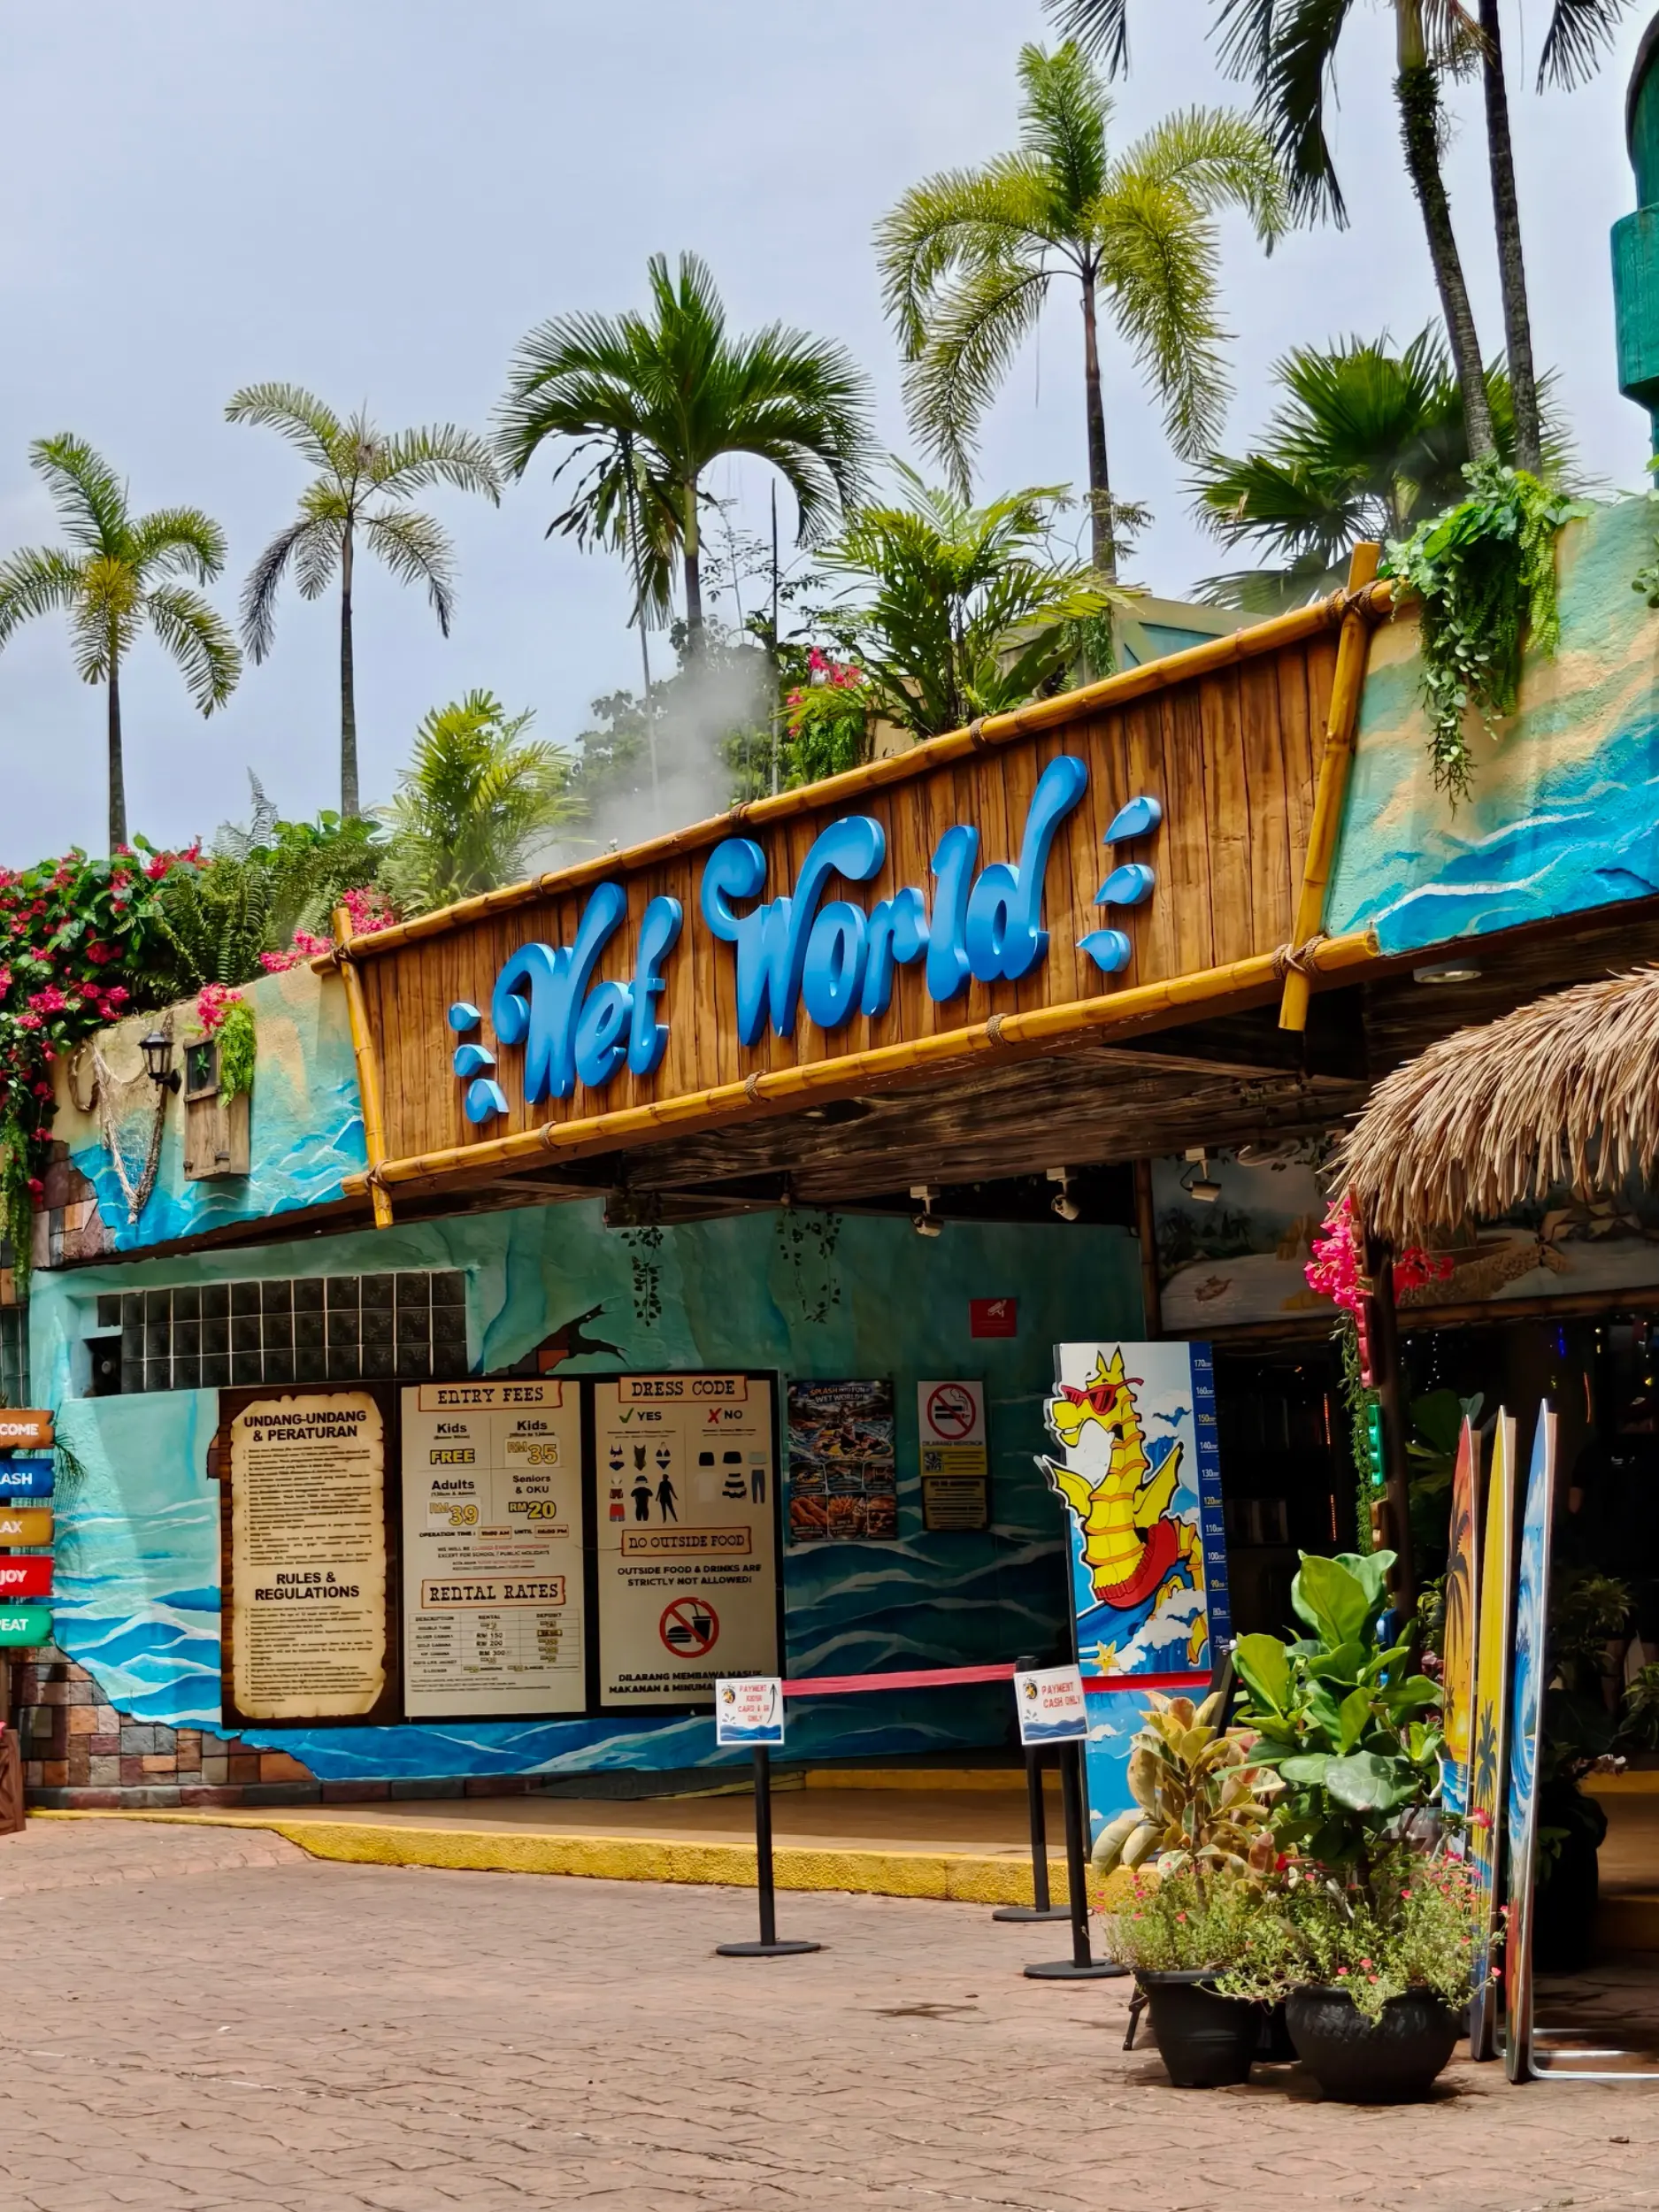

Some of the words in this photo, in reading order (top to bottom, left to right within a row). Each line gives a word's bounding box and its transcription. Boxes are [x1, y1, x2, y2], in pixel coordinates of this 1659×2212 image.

[491, 881, 683, 1104] Wet
[701, 755, 1087, 1048] World
[503, 1386, 543, 1402] FEES
[632, 1380, 683, 1396] DRESS
[692, 1380, 735, 1395] CODE
[244, 1410, 366, 1427] UNDANG-UNDANG
[637, 1411, 662, 1421] YES
[724, 1409, 743, 1419] NO
[437, 1423, 467, 1433] Kids
[517, 1420, 548, 1431] Kids
[253, 1430, 263, 1441] &
[268, 1425, 357, 1441] PERATURAN
[430, 1448, 475, 1464] FREE
[0, 1472, 33, 1485] ASH
[432, 1479, 474, 1490] Adults
[512, 1474, 551, 1483] Seniors
[0, 1521, 23, 1533] AX
[650, 1536, 707, 1548] OUTSIDE
[710, 1535, 745, 1547] FOOD
[277, 1572, 321, 1585] RULES
[326, 1571, 336, 1583] &
[628, 1578, 674, 1586] STRICTLY
[255, 1586, 359, 1601] REGULATIONS
[503, 1584, 559, 1600] RATES
[618, 1672, 670, 1681] DILARANG
[672, 1671, 725, 1680] MEMBAWA
[609, 1685, 661, 1694] MAKANAN
[672, 1683, 715, 1692] MINUMA
[1041, 1681, 1073, 1695] PAYMENT
